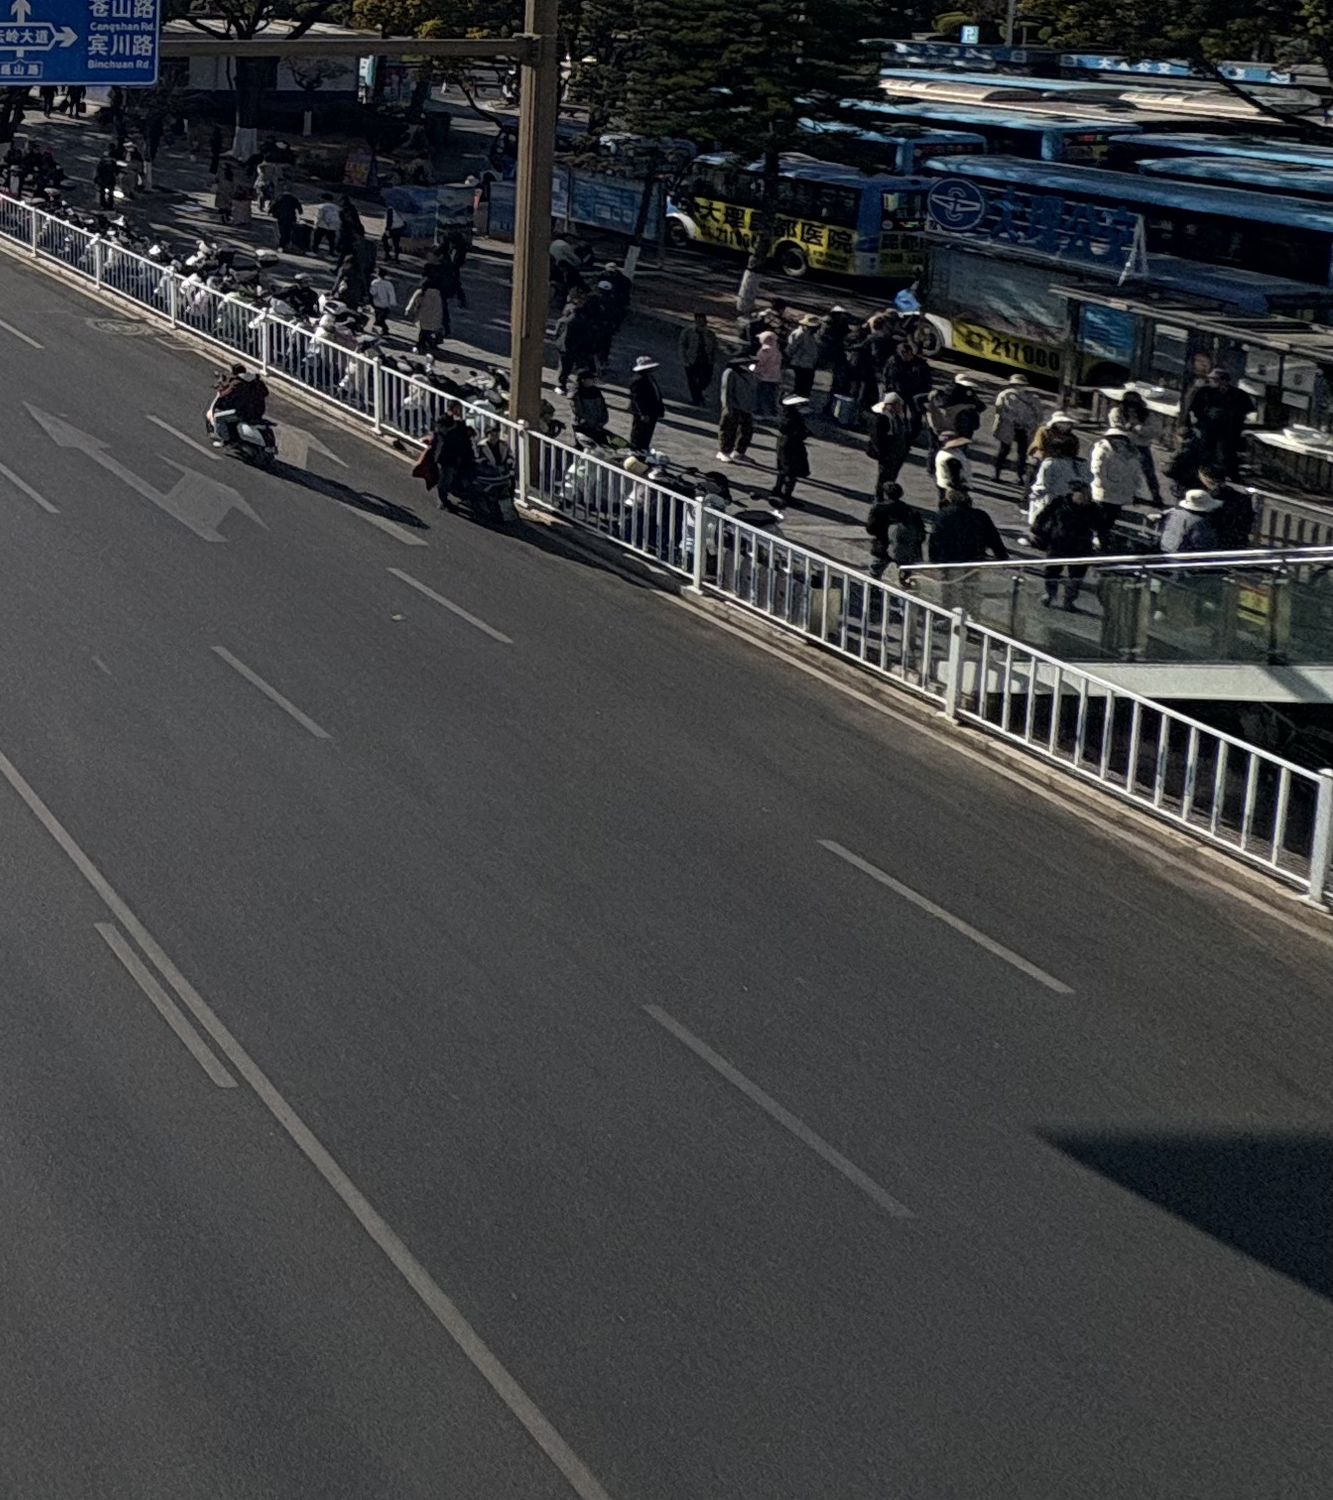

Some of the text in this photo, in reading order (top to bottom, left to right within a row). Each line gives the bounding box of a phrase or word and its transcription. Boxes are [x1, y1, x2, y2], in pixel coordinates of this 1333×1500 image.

[90, 21, 157, 33] Cangshan Rd.
[87, 33, 154, 57] 宾川路
[87, 59, 153, 70] Binchuan Rd.
